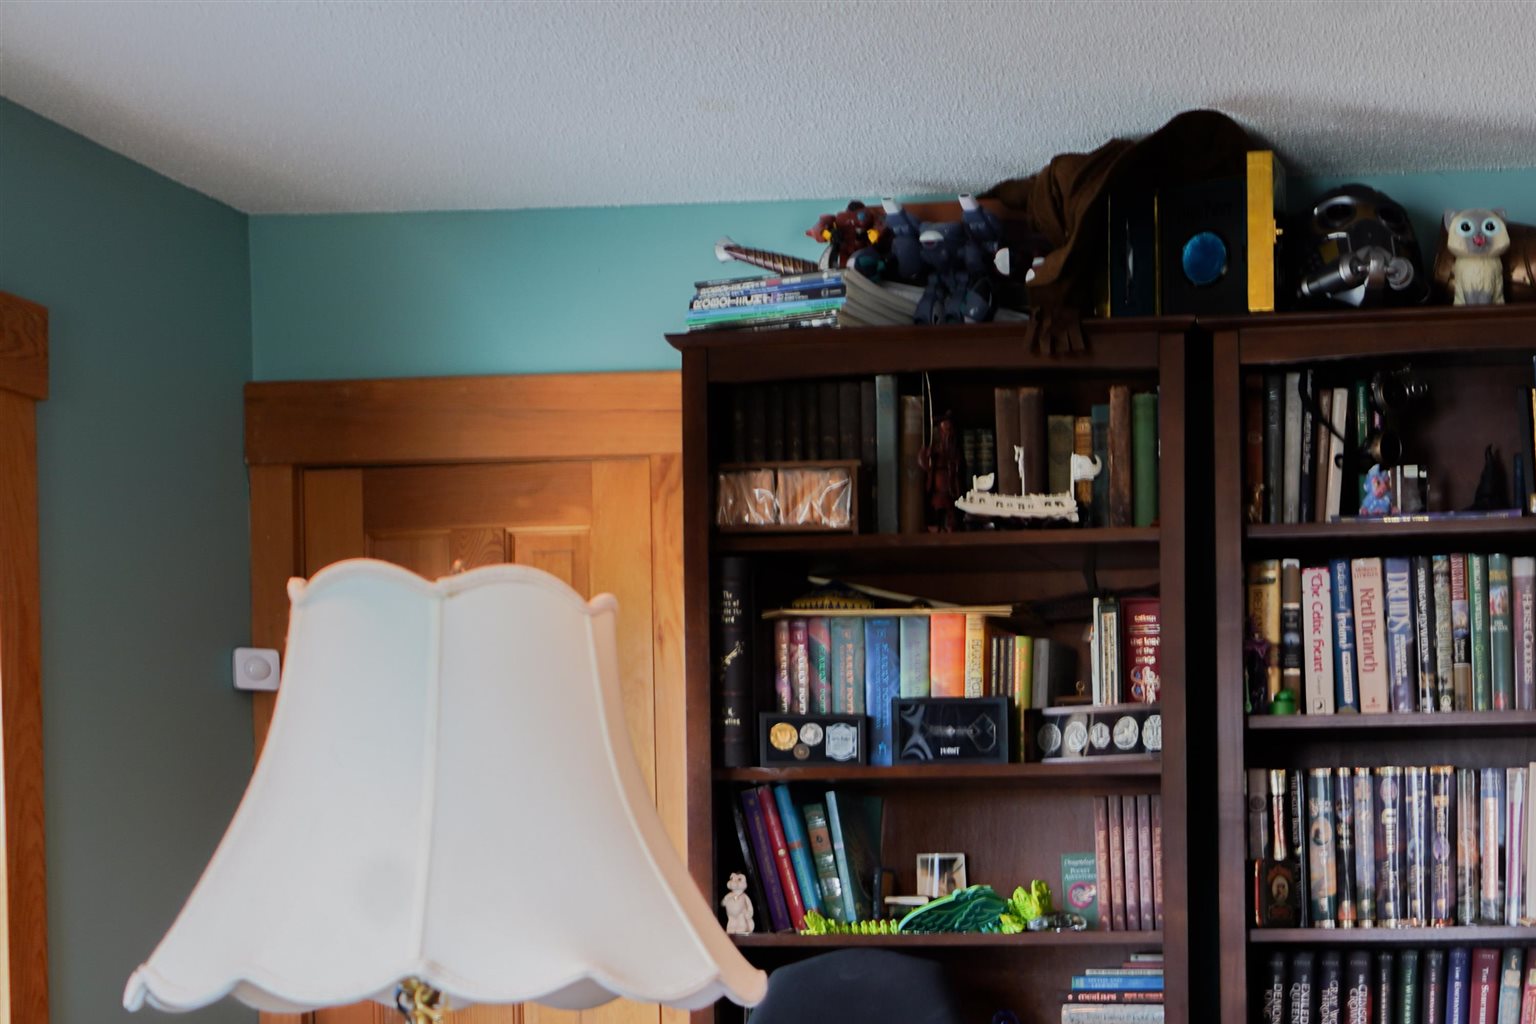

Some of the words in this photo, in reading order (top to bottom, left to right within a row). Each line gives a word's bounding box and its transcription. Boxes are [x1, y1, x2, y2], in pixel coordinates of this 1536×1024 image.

[1311, 574, 1325, 598] The
[1359, 588, 1376, 617] Red
[1386, 572, 1411, 634] DRUIDS
[1312, 601, 1324, 636] Celtic
[1313, 639, 1326, 673] Heart
[1361, 619, 1378, 673] Branch
